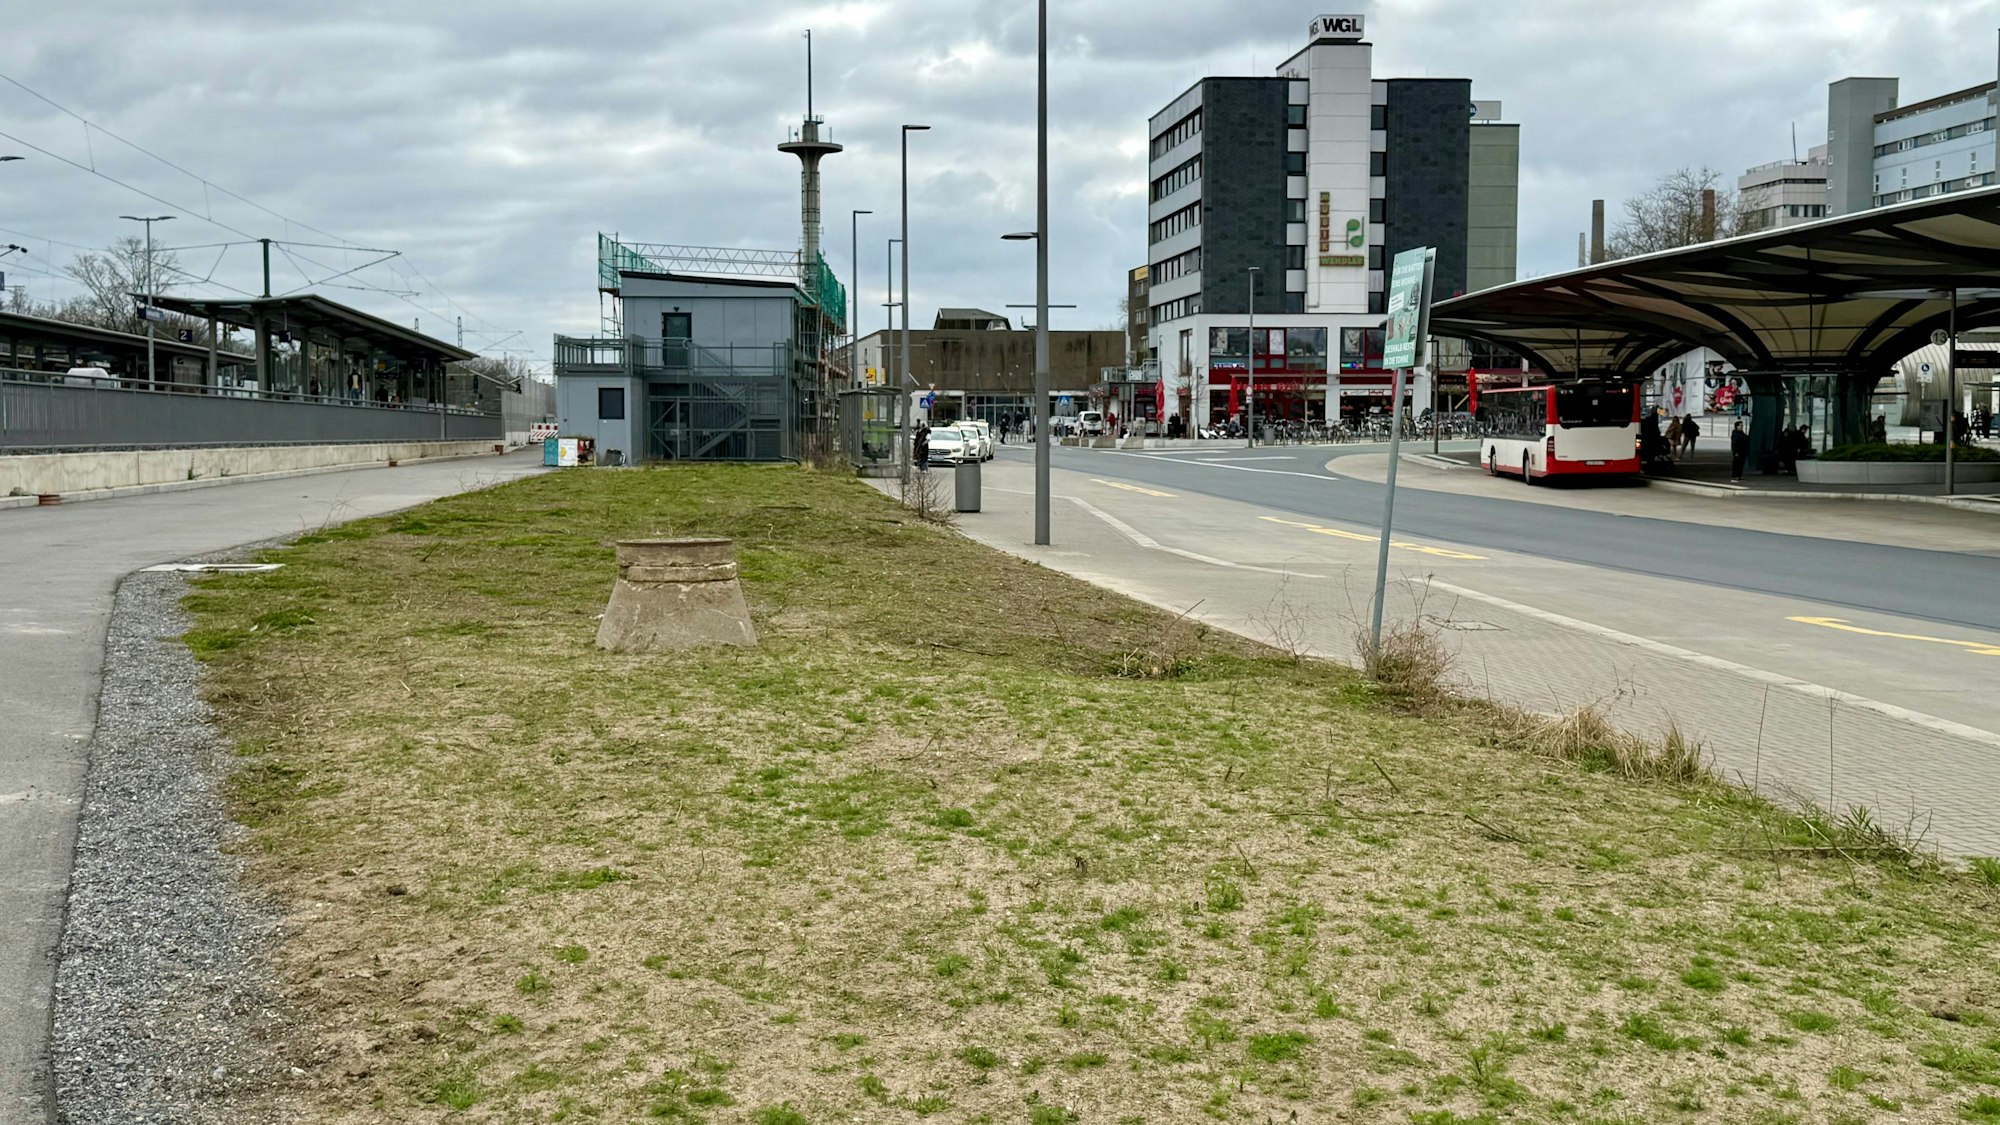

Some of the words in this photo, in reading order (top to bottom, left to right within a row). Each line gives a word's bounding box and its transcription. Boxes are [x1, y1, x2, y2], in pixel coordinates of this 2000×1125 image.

[1322, 18, 1361, 32] WGL
[180, 330, 187, 340] 2
[1933, 332, 1946, 342] 13
[1385, 343, 1402, 354] DESHALB
[1403, 341, 1415, 351] RESTE
[1396, 354, 1409, 364] TONNE
